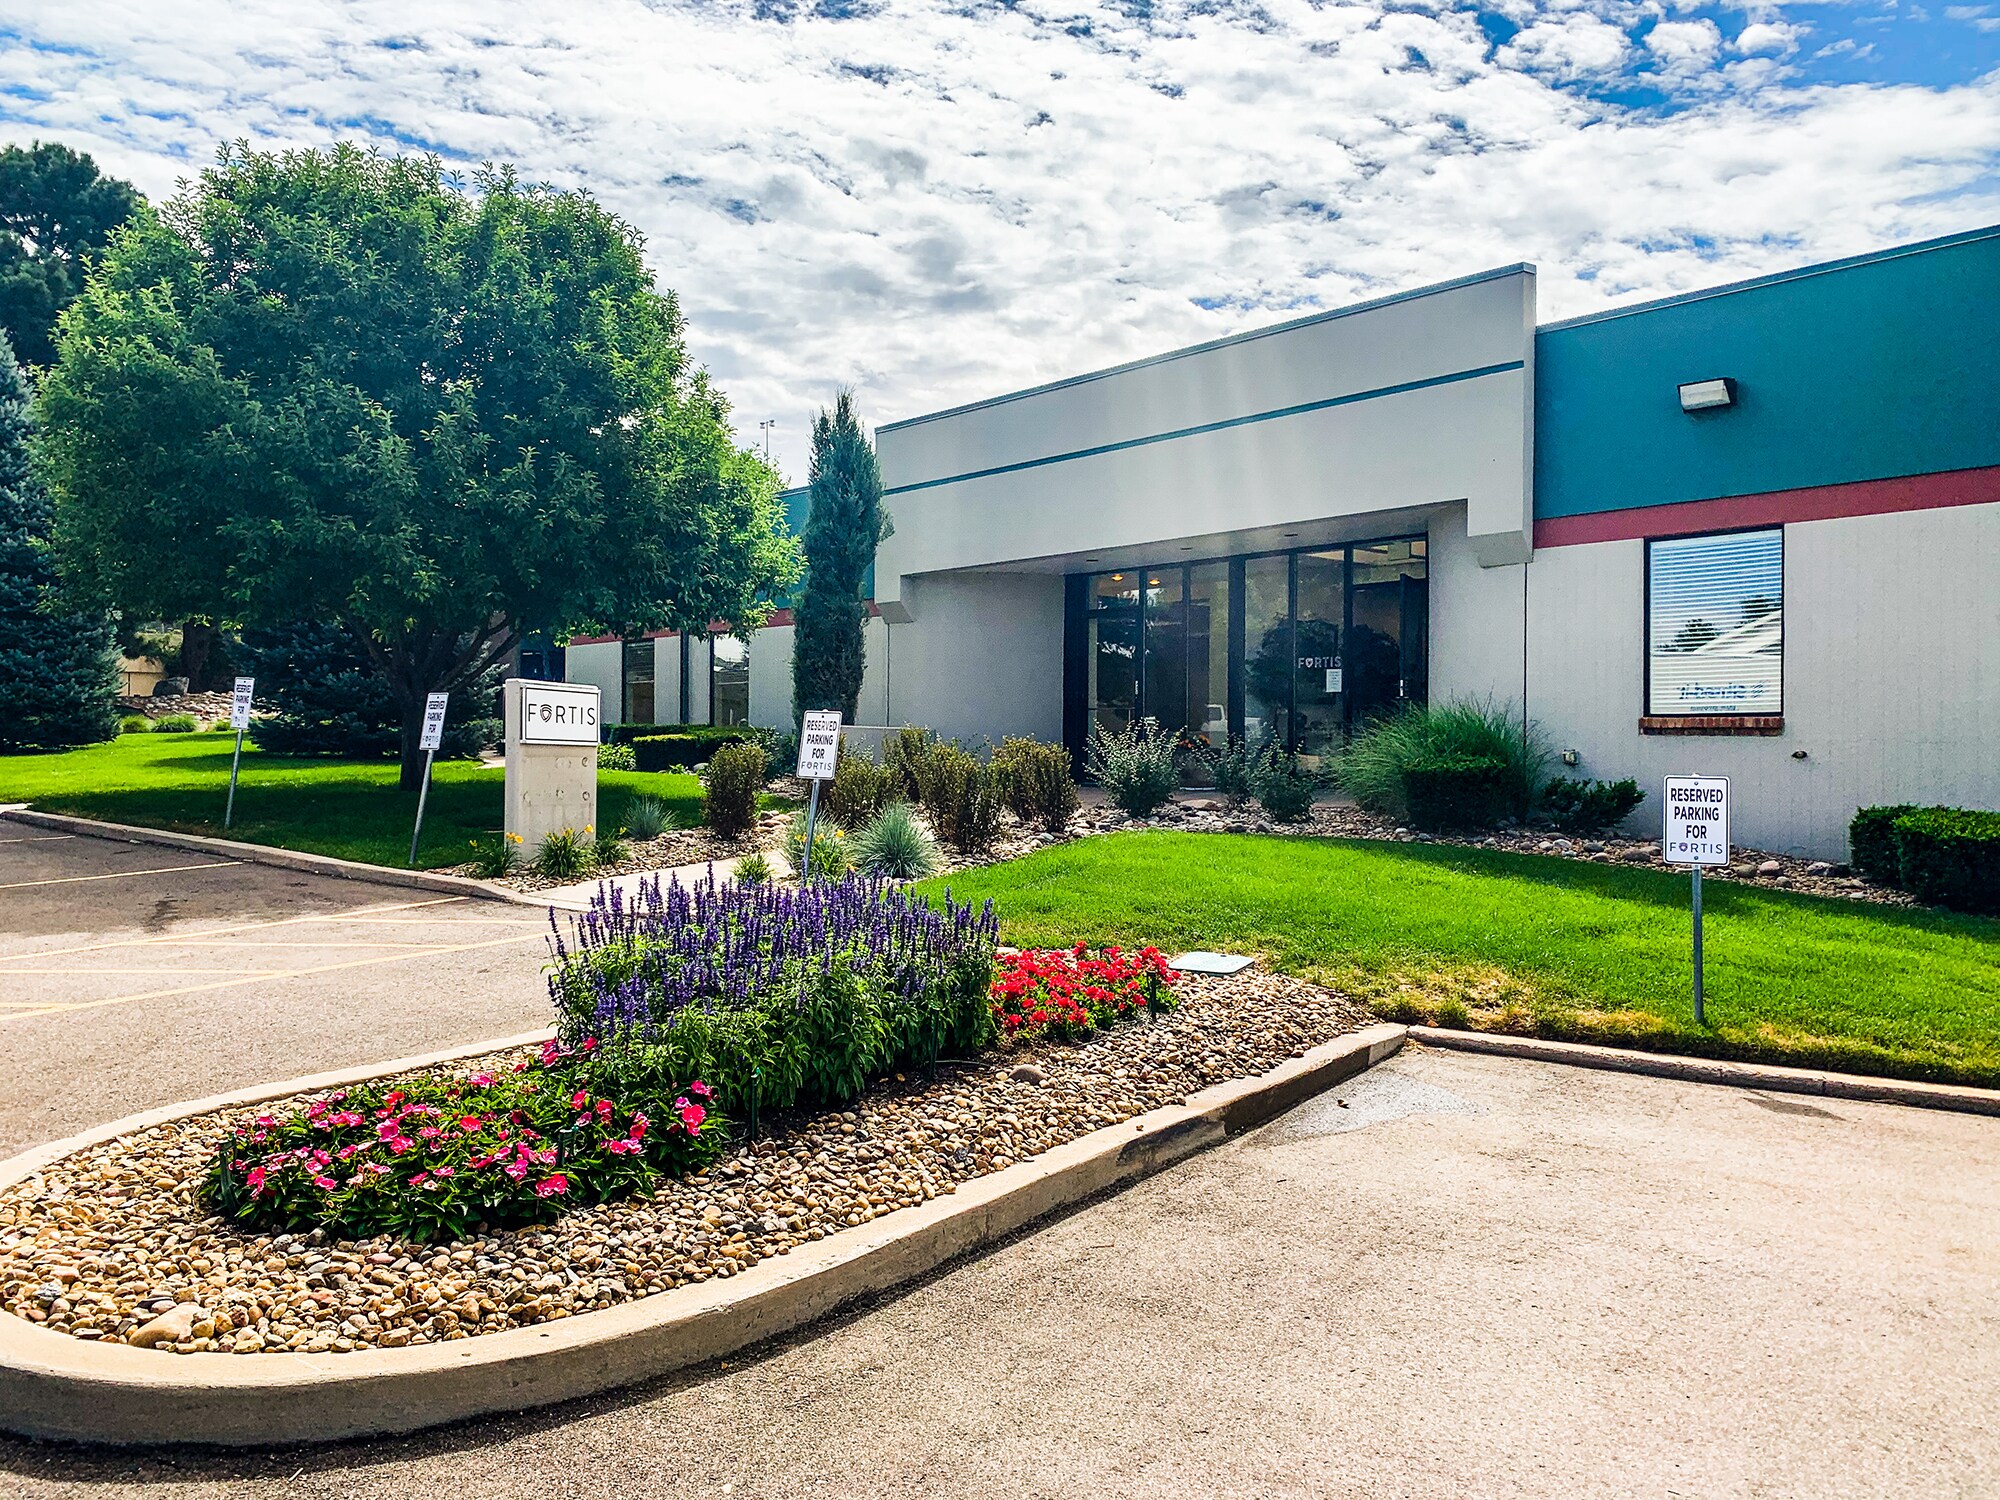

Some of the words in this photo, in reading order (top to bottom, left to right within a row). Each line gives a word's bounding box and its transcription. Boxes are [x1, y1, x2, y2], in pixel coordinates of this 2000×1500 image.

[1298, 656, 1343, 669] FORTIS
[528, 703, 596, 726] FORTIS
[806, 719, 838, 732] RESERVED
[806, 734, 834, 746] PARKING
[811, 748, 826, 759] FOR
[801, 761, 832, 771] FORTIS
[1670, 787, 1724, 803] RESERVED
[1673, 806, 1720, 821] PARKING
[1685, 824, 1707, 839] FOR
[1669, 842, 1724, 855] FORTIS
